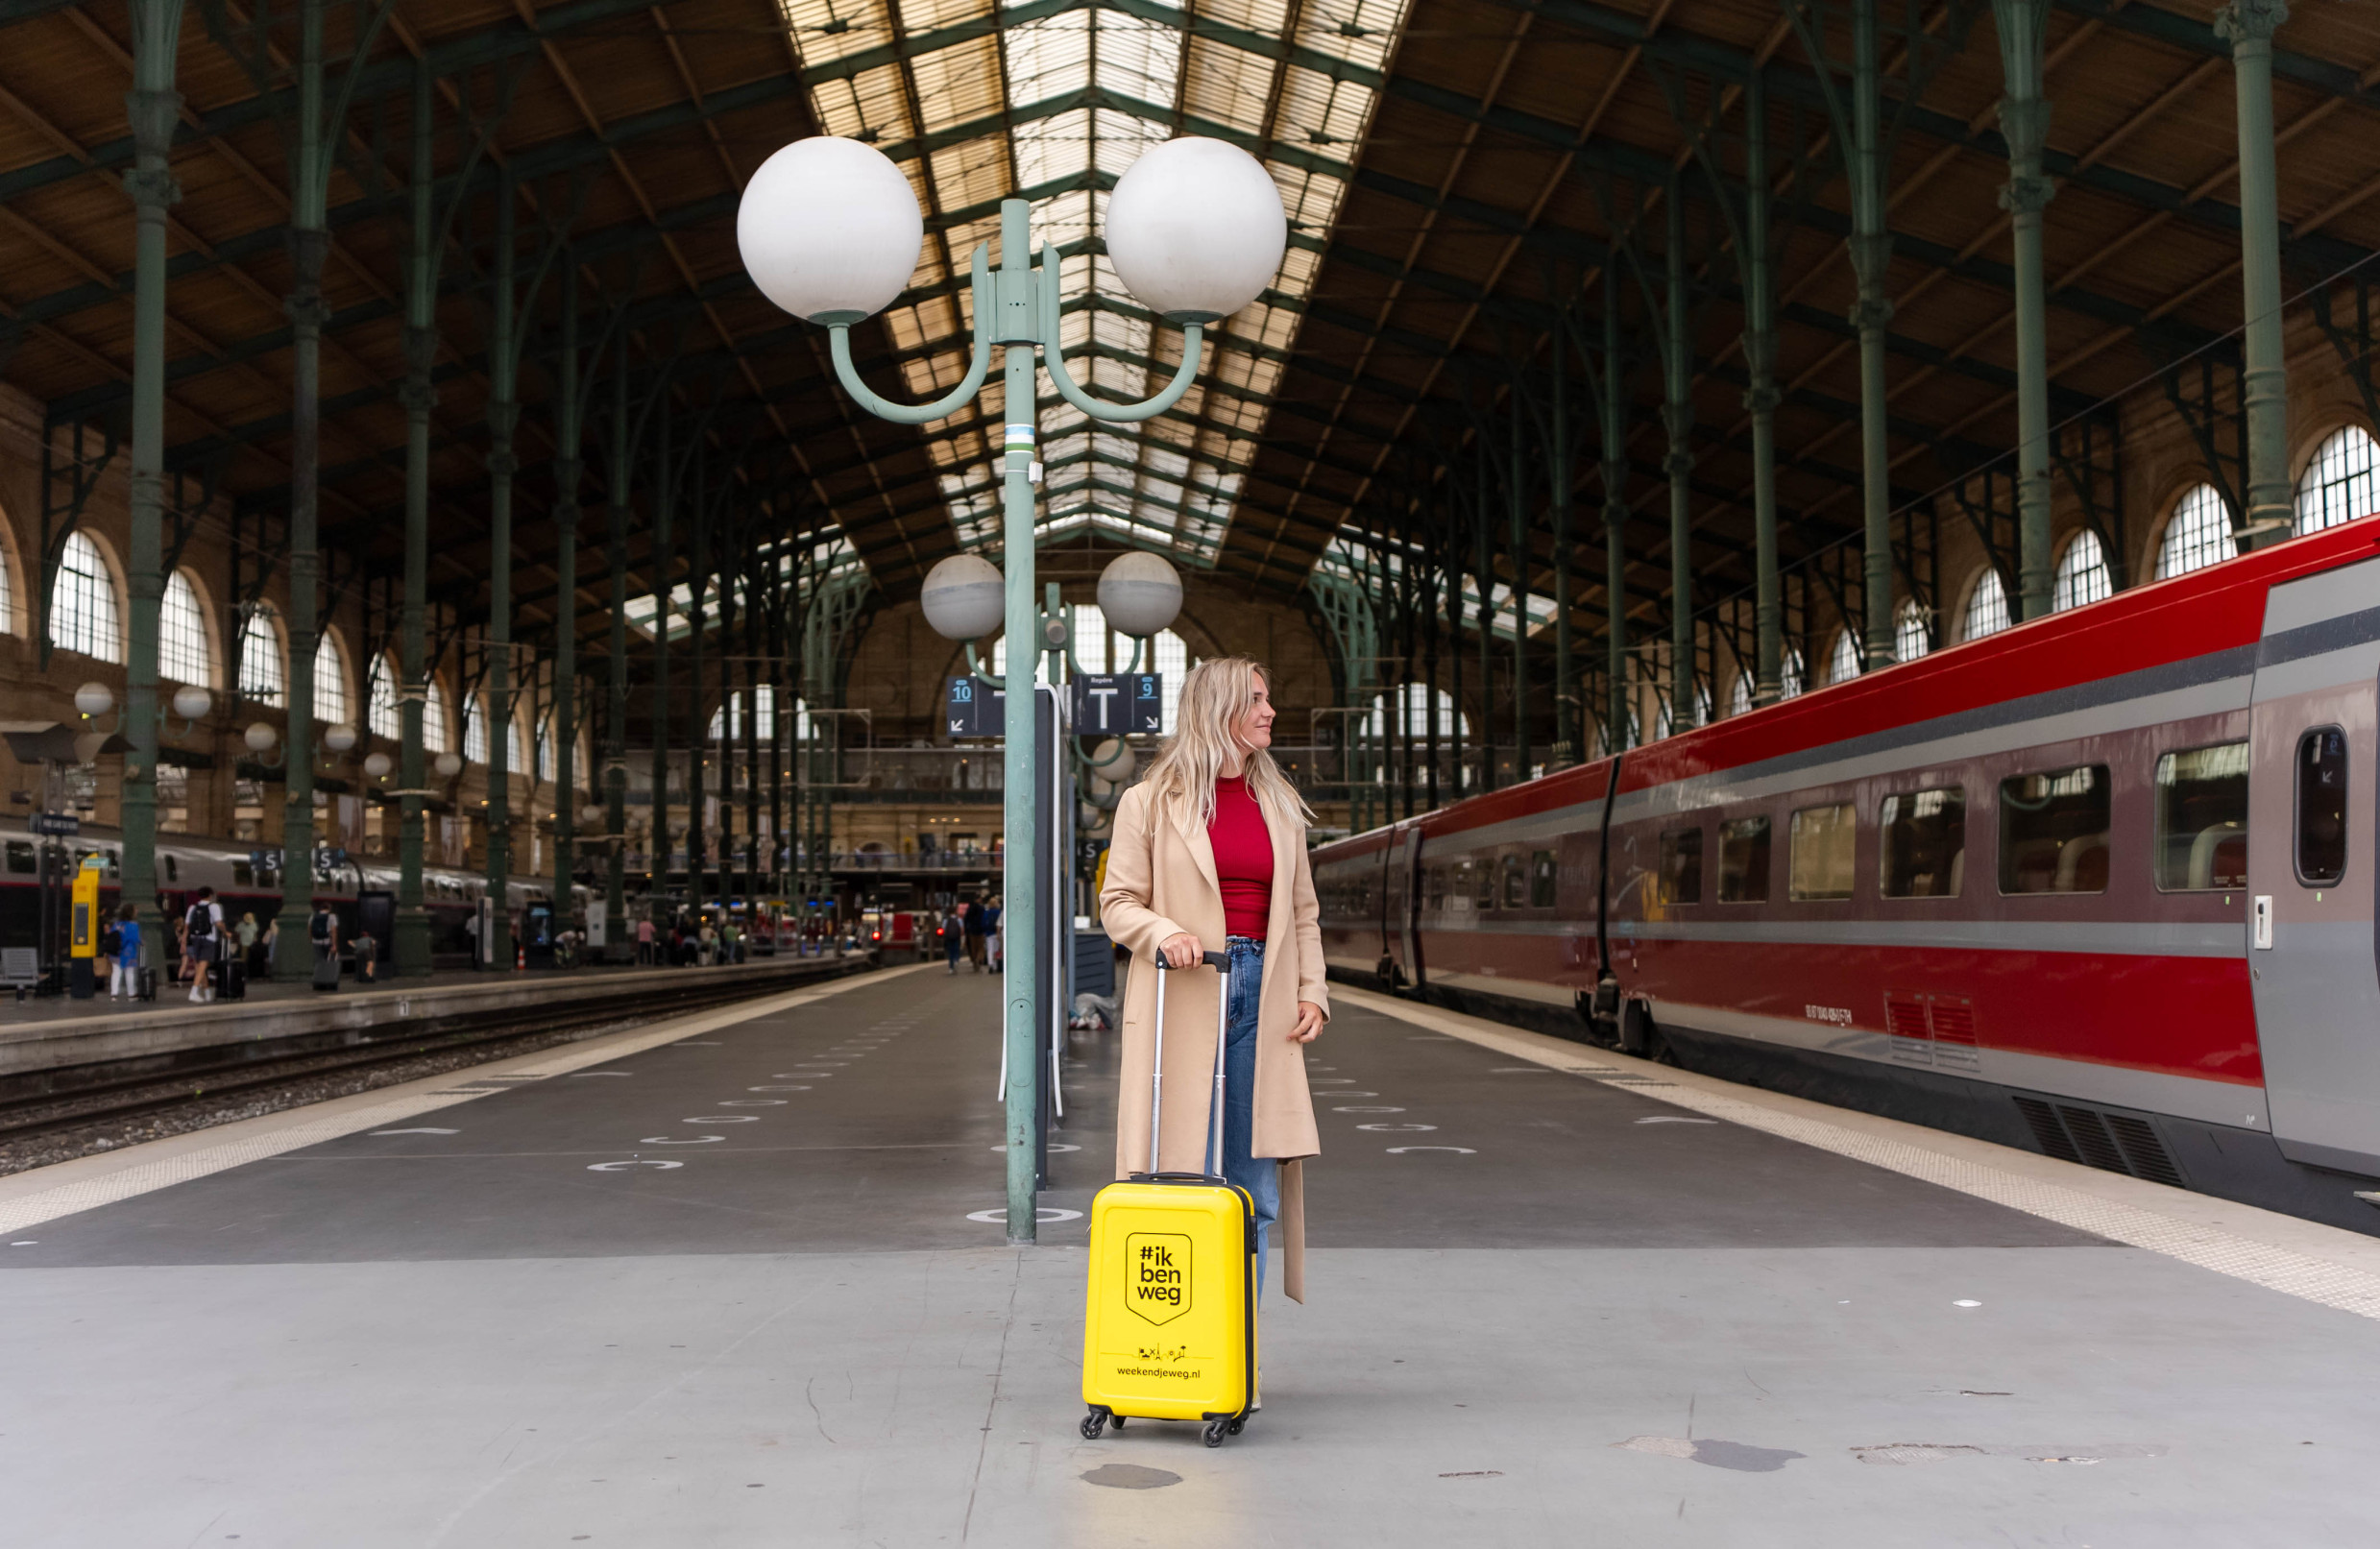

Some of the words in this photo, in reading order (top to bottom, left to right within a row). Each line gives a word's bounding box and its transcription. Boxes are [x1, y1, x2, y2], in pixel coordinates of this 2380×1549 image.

[952, 686, 972, 700] 10
[1142, 683, 1154, 697] 9
[1089, 688, 1118, 730] T
[320, 851, 331, 868] S
[1085, 843, 1096, 859] S
[265, 853, 277, 870] S
[1140, 1246, 1174, 1267] #ik
[1140, 1262, 1180, 1284] ben
[1137, 1286, 1181, 1306] weg
[1117, 1366, 1201, 1380] weekendjeweg.nl
